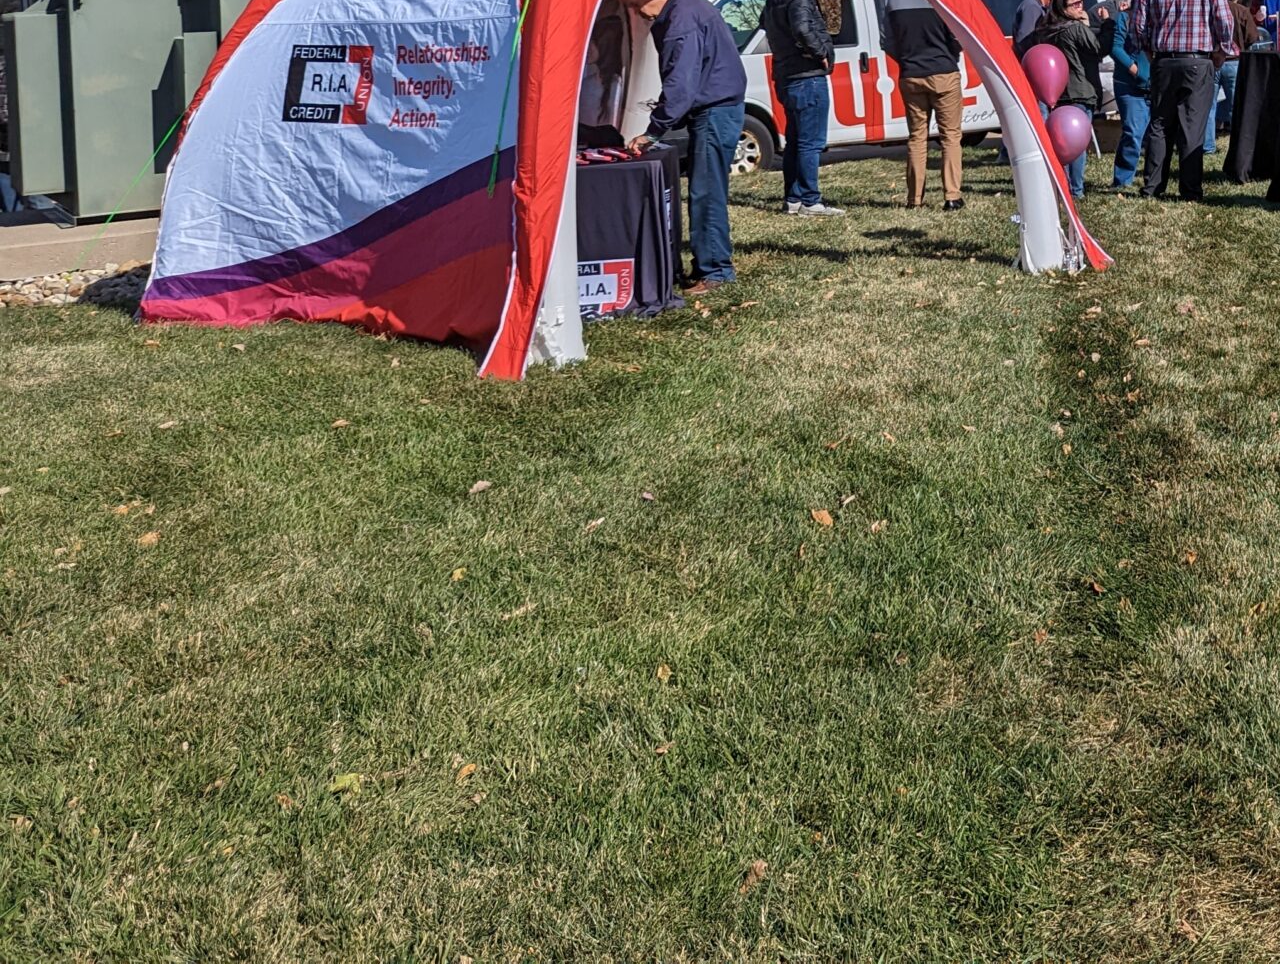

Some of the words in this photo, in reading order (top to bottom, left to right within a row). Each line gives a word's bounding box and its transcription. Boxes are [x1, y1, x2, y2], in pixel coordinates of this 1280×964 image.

[293, 46, 344, 60] FEDERAL
[396, 41, 490, 65] Relationships.
[311, 73, 351, 93] R.I.A.
[356, 57, 372, 111] UNION
[393, 76, 456, 100] Integrity.
[289, 106, 335, 120] CREDIT
[388, 108, 440, 128] Action.
[579, 282, 612, 298] .I.A.
[617, 268, 630, 304] UNION
